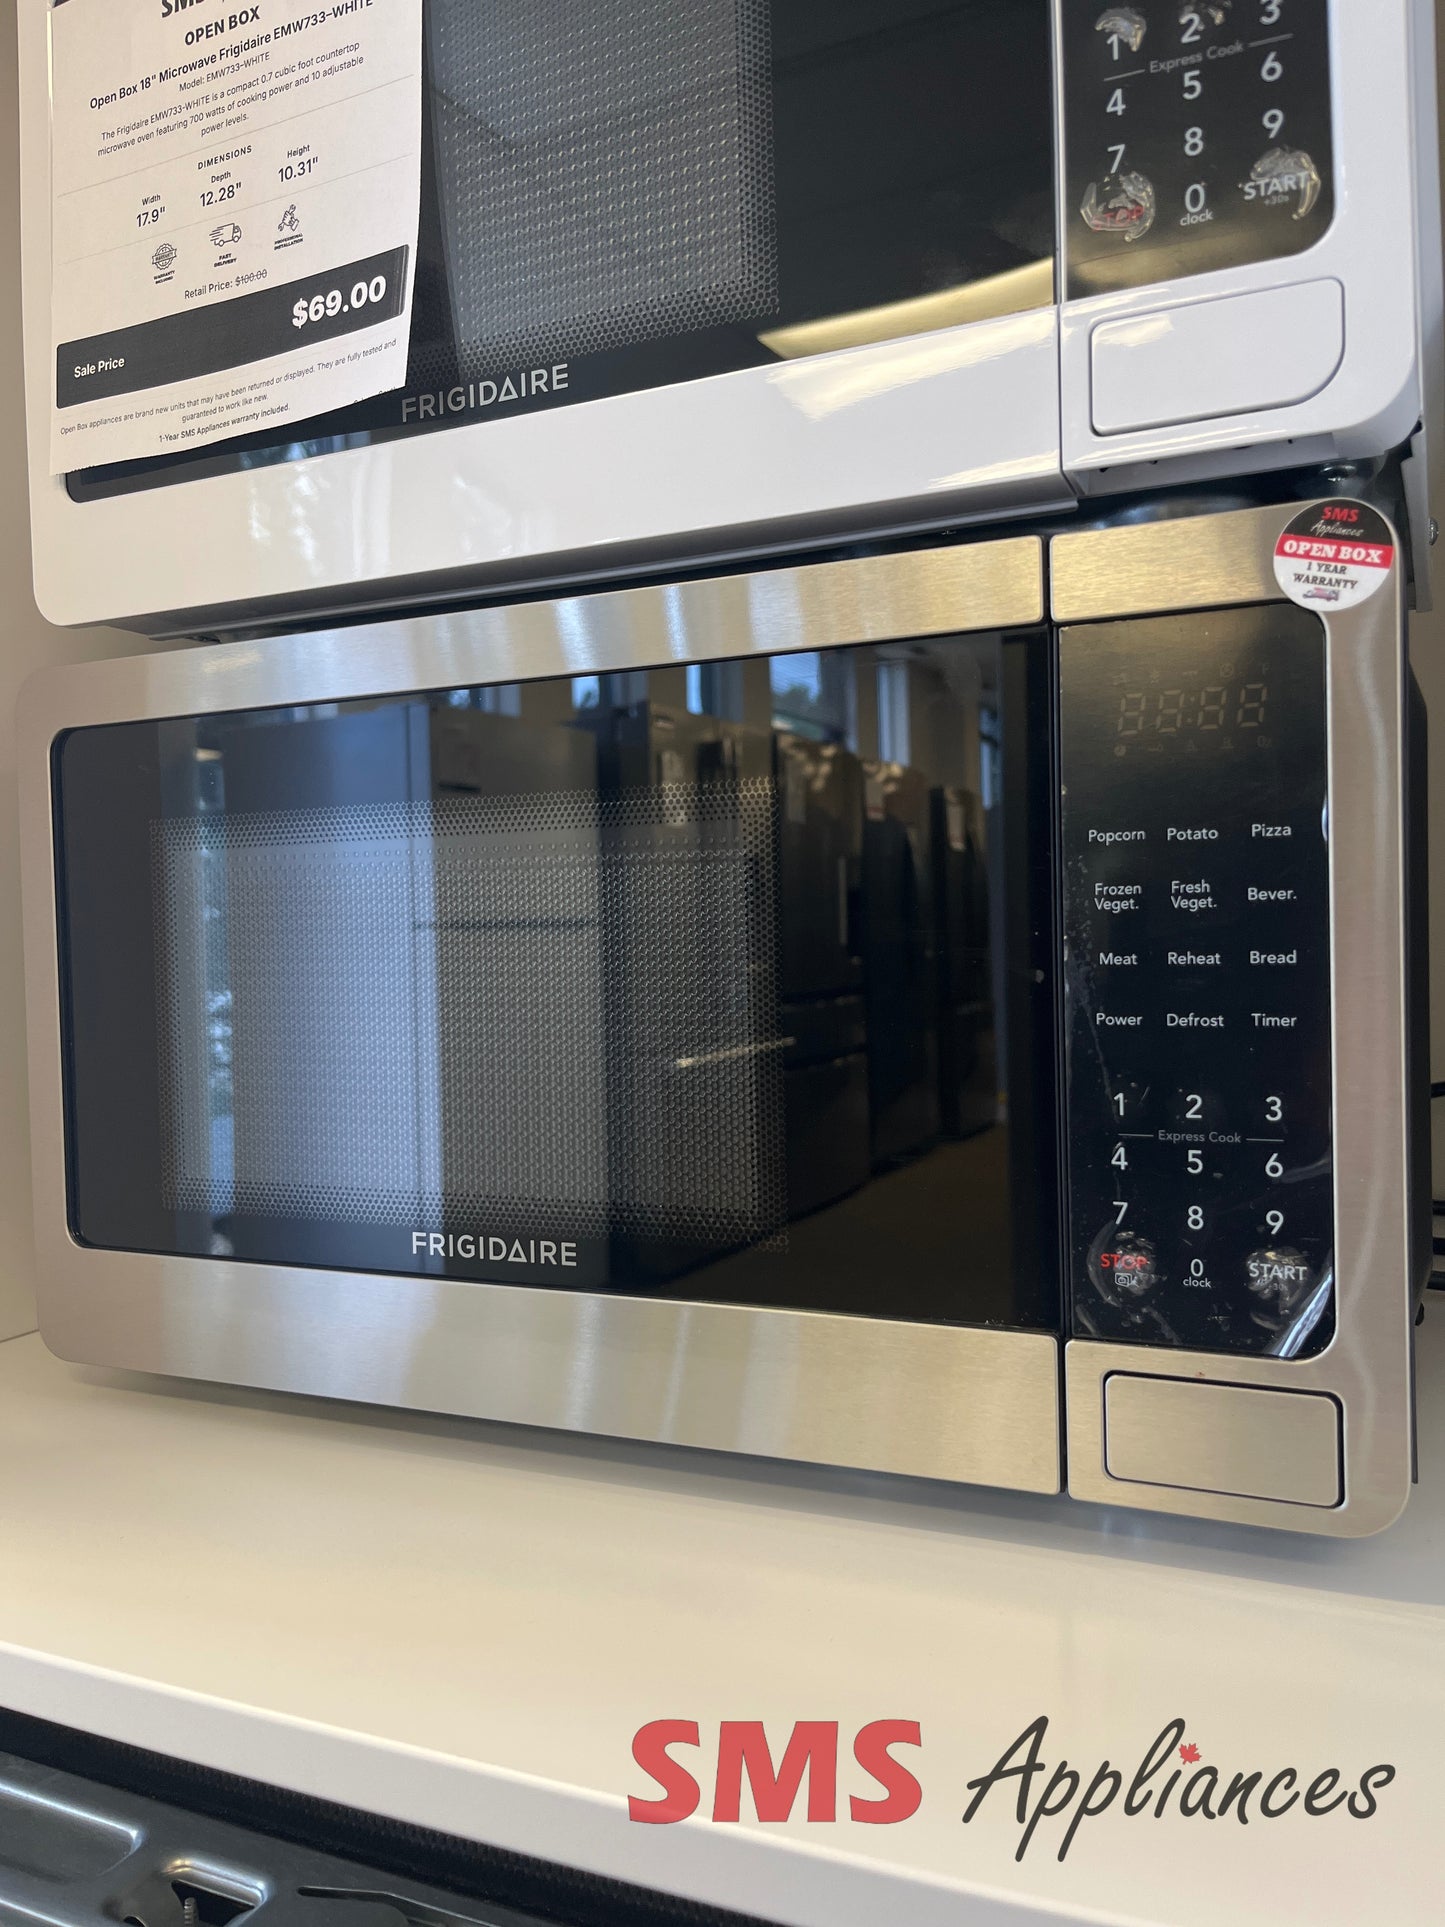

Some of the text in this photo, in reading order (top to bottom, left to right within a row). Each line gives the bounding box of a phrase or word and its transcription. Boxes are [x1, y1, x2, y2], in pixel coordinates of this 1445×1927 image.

[162, 0, 205, 18] SM
[1259, 0, 1282, 25] 3
[185, 5, 260, 45] OPEN BOX
[1180, 13, 1201, 44] 2
[1106, 34, 1120, 61] 1
[1150, 41, 1244, 75] Express Cook
[89, 93, 117, 110] Open
[119, 84, 138, 99] Box
[140, 74, 156, 90] 18"
[159, 54, 217, 82] Microwave
[219, 34, 271, 61] Frigidaire
[1261, 52, 1283, 82] 6
[102, 131, 115, 140] The
[116, 119, 149, 136] Frigidaire
[212, 92, 218, 101] is
[220, 91, 225, 99] a
[227, 77, 260, 97] compact
[261, 72, 273, 84] 0.7
[274, 63, 296, 79] cubic
[298, 58, 314, 71] foot
[315, 42, 360, 64] countertop
[179, 77, 205, 92] Model:
[1183, 70, 1201, 100] 5
[97, 56, 364, 156] microwave oven featuring 700 watts of cooking power and 10 adjustable
[1106, 88, 1126, 116] 4
[201, 113, 249, 137] power levels.
[1262, 109, 1284, 139] 9
[287, 144, 310, 159] Height
[1184, 127, 1204, 156] 8
[198, 145, 252, 170] DIMENSIONS
[1107, 144, 1126, 174] 7
[211, 171, 231, 184] Depth
[278, 157, 319, 183] 10.31"
[200, 182, 242, 207] 12.28"
[1185, 184, 1205, 213] 0
[1244, 172, 1310, 201] START
[142, 194, 161, 206] Width
[136, 206, 166, 228] 17.9"
[1092, 205, 1145, 231] STOP
[1180, 209, 1213, 227] clock
[184, 285, 207, 300] Retail
[208, 280, 233, 294] Price:
[292, 275, 387, 330] $69.00
[74, 356, 125, 379] Sale Price
[60, 426, 76, 436] Open
[77, 422, 88, 431] Box
[89, 416, 122, 430] appliances
[123, 413, 134, 422] are
[135, 409, 153, 419] brand
[155, 406, 169, 414] new
[170, 402, 185, 411] units
[187, 399, 200, 408] that
[200, 396, 213, 407] may
[215, 392, 230, 402] have
[231, 388, 246, 397] been
[248, 377, 274, 392] returned
[275, 376, 283, 384] or
[317, 361, 333, 371] They
[335, 358, 346, 366] are
[347, 351, 361, 363] fully
[362, 345, 383, 358] tested
[383, 339, 397, 349] and
[401, 363, 569, 423] FRIGIDAIRE
[182, 406, 217, 423] guaranteed
[218, 404, 224, 413] to
[225, 401, 241, 411] work
[242, 397, 252, 406] like
[159, 433, 179, 442] 1-Year
[180, 428, 195, 439] SMS
[197, 420, 230, 436] Appliances
[231, 412, 260, 425] warranty
[1321, 506, 1360, 523] SMS
[1310, 520, 1365, 538] Appliances
[1283, 540, 1383, 564] OPEN BOX
[1306, 562, 1347, 575] 1 YEAR
[1293, 573, 1358, 590] WARRANTY
[1088, 829, 1146, 846] Popcorn
[1166, 827, 1219, 841] Potato
[1251, 823, 1292, 838] Pizza
[1094, 882, 1142, 896] Frozen
[1171, 880, 1211, 895] Fresh
[1247, 888, 1297, 902] Bever.
[1094, 898, 1140, 913] Veget.
[1170, 896, 1217, 912] Veget.
[1099, 952, 1138, 967] Meat
[1167, 952, 1221, 966] Reheat
[1249, 950, 1297, 965] Bread
[1096, 1013, 1143, 1027] Power
[1166, 1013, 1224, 1028] Defrost
[1251, 1013, 1298, 1028] Timer
[1113, 1092, 1125, 1116] 1
[1185, 1094, 1203, 1119] 2
[1265, 1096, 1282, 1121] 3
[1158, 1130, 1242, 1144] Express Cook
[1111, 1147, 1128, 1170] 4
[1187, 1150, 1203, 1174] 5
[1265, 1153, 1284, 1178] 6
[1112, 1201, 1128, 1225] 7
[1187, 1206, 1204, 1230] 8
[1265, 1210, 1284, 1235] 9
[412, 1231, 577, 1267] FRIGIDAIRE
[1100, 1253, 1148, 1271] STOP
[1190, 1259, 1204, 1277] 0
[1249, 1262, 1308, 1281] START
[1183, 1277, 1211, 1289] clock
